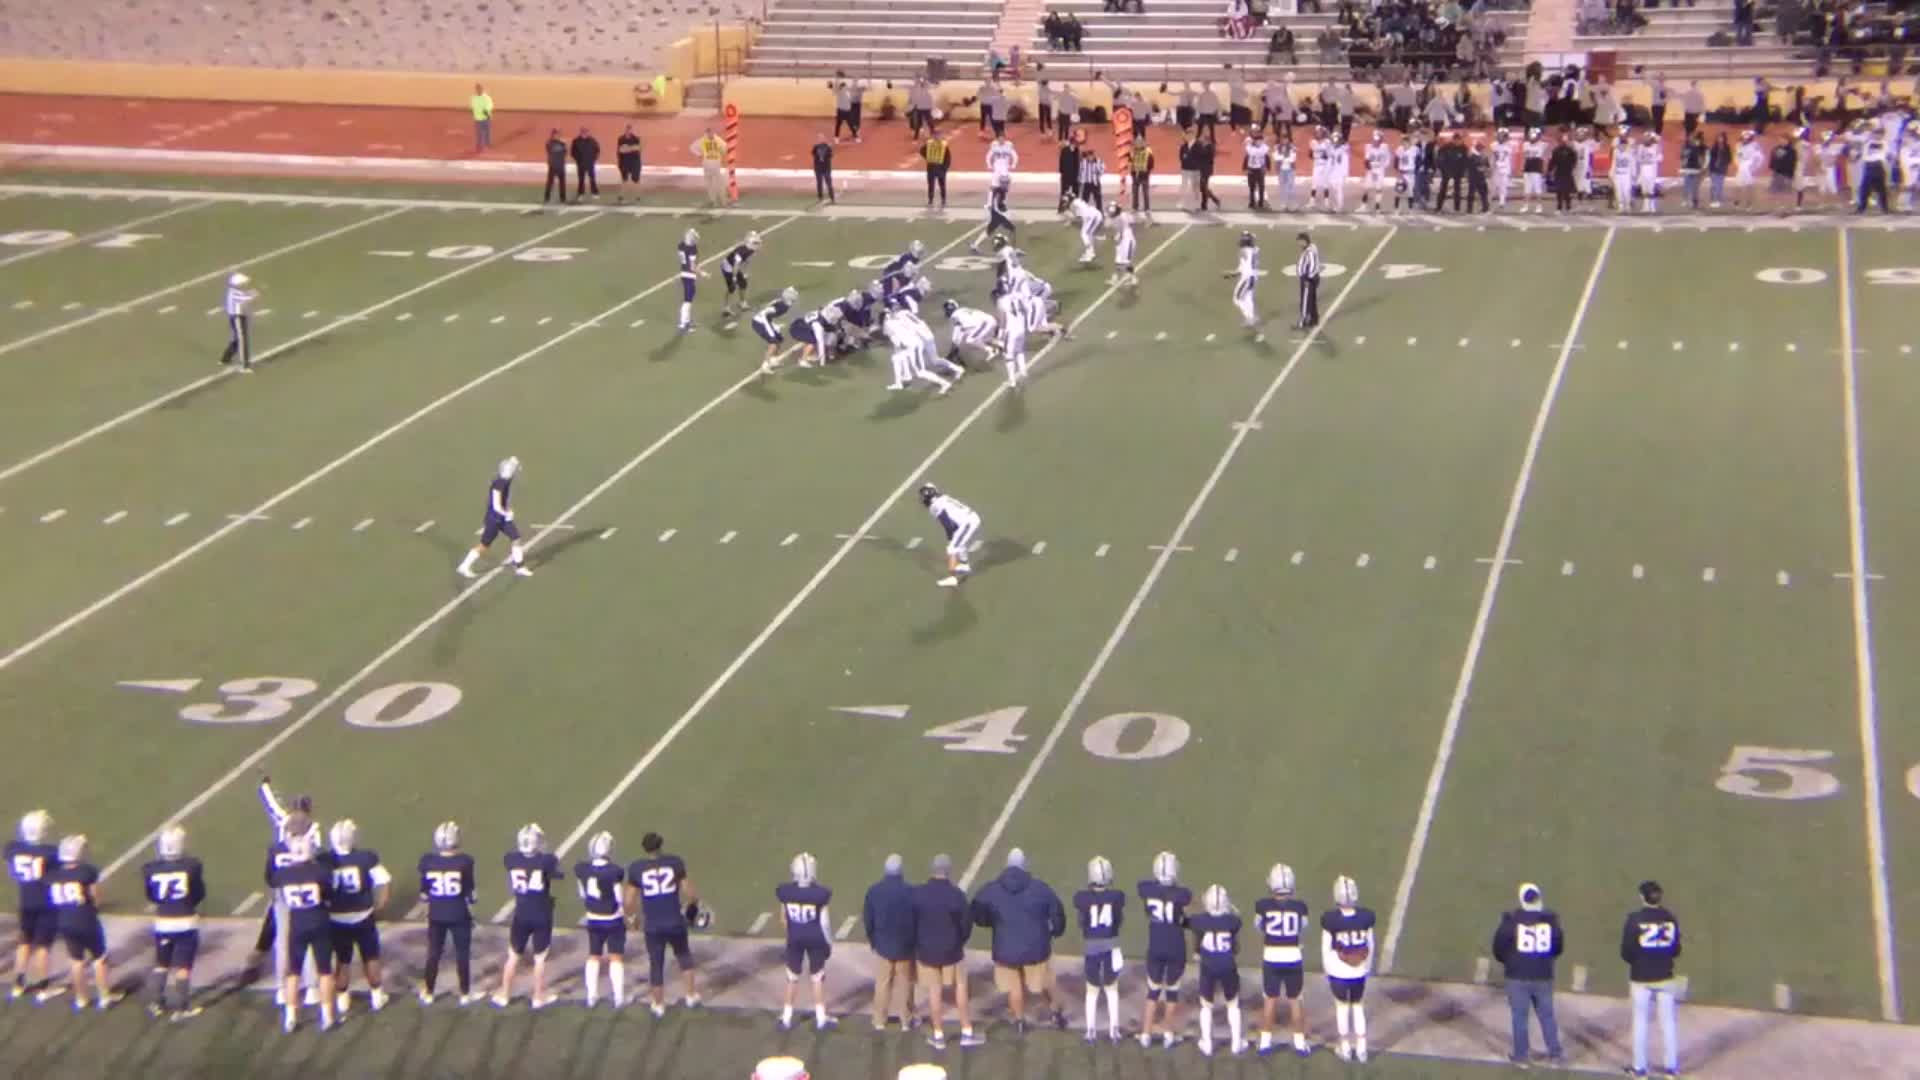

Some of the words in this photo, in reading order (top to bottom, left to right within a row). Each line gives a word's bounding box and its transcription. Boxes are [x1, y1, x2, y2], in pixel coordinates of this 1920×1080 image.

[177, 676, 462, 728] 30
[923, 706, 1191, 760] 40
[150, 872, 189, 900] 73
[426, 870, 461, 897] 36
[641, 867, 676, 896] 52
[1089, 904, 1113, 928] 14
[1147, 899, 1175, 924] 31
[1265, 911, 1299, 936] 20
[1201, 931, 1231, 952] 46
[1516, 922, 1552, 953] 68
[1638, 921, 1677, 948] 23
